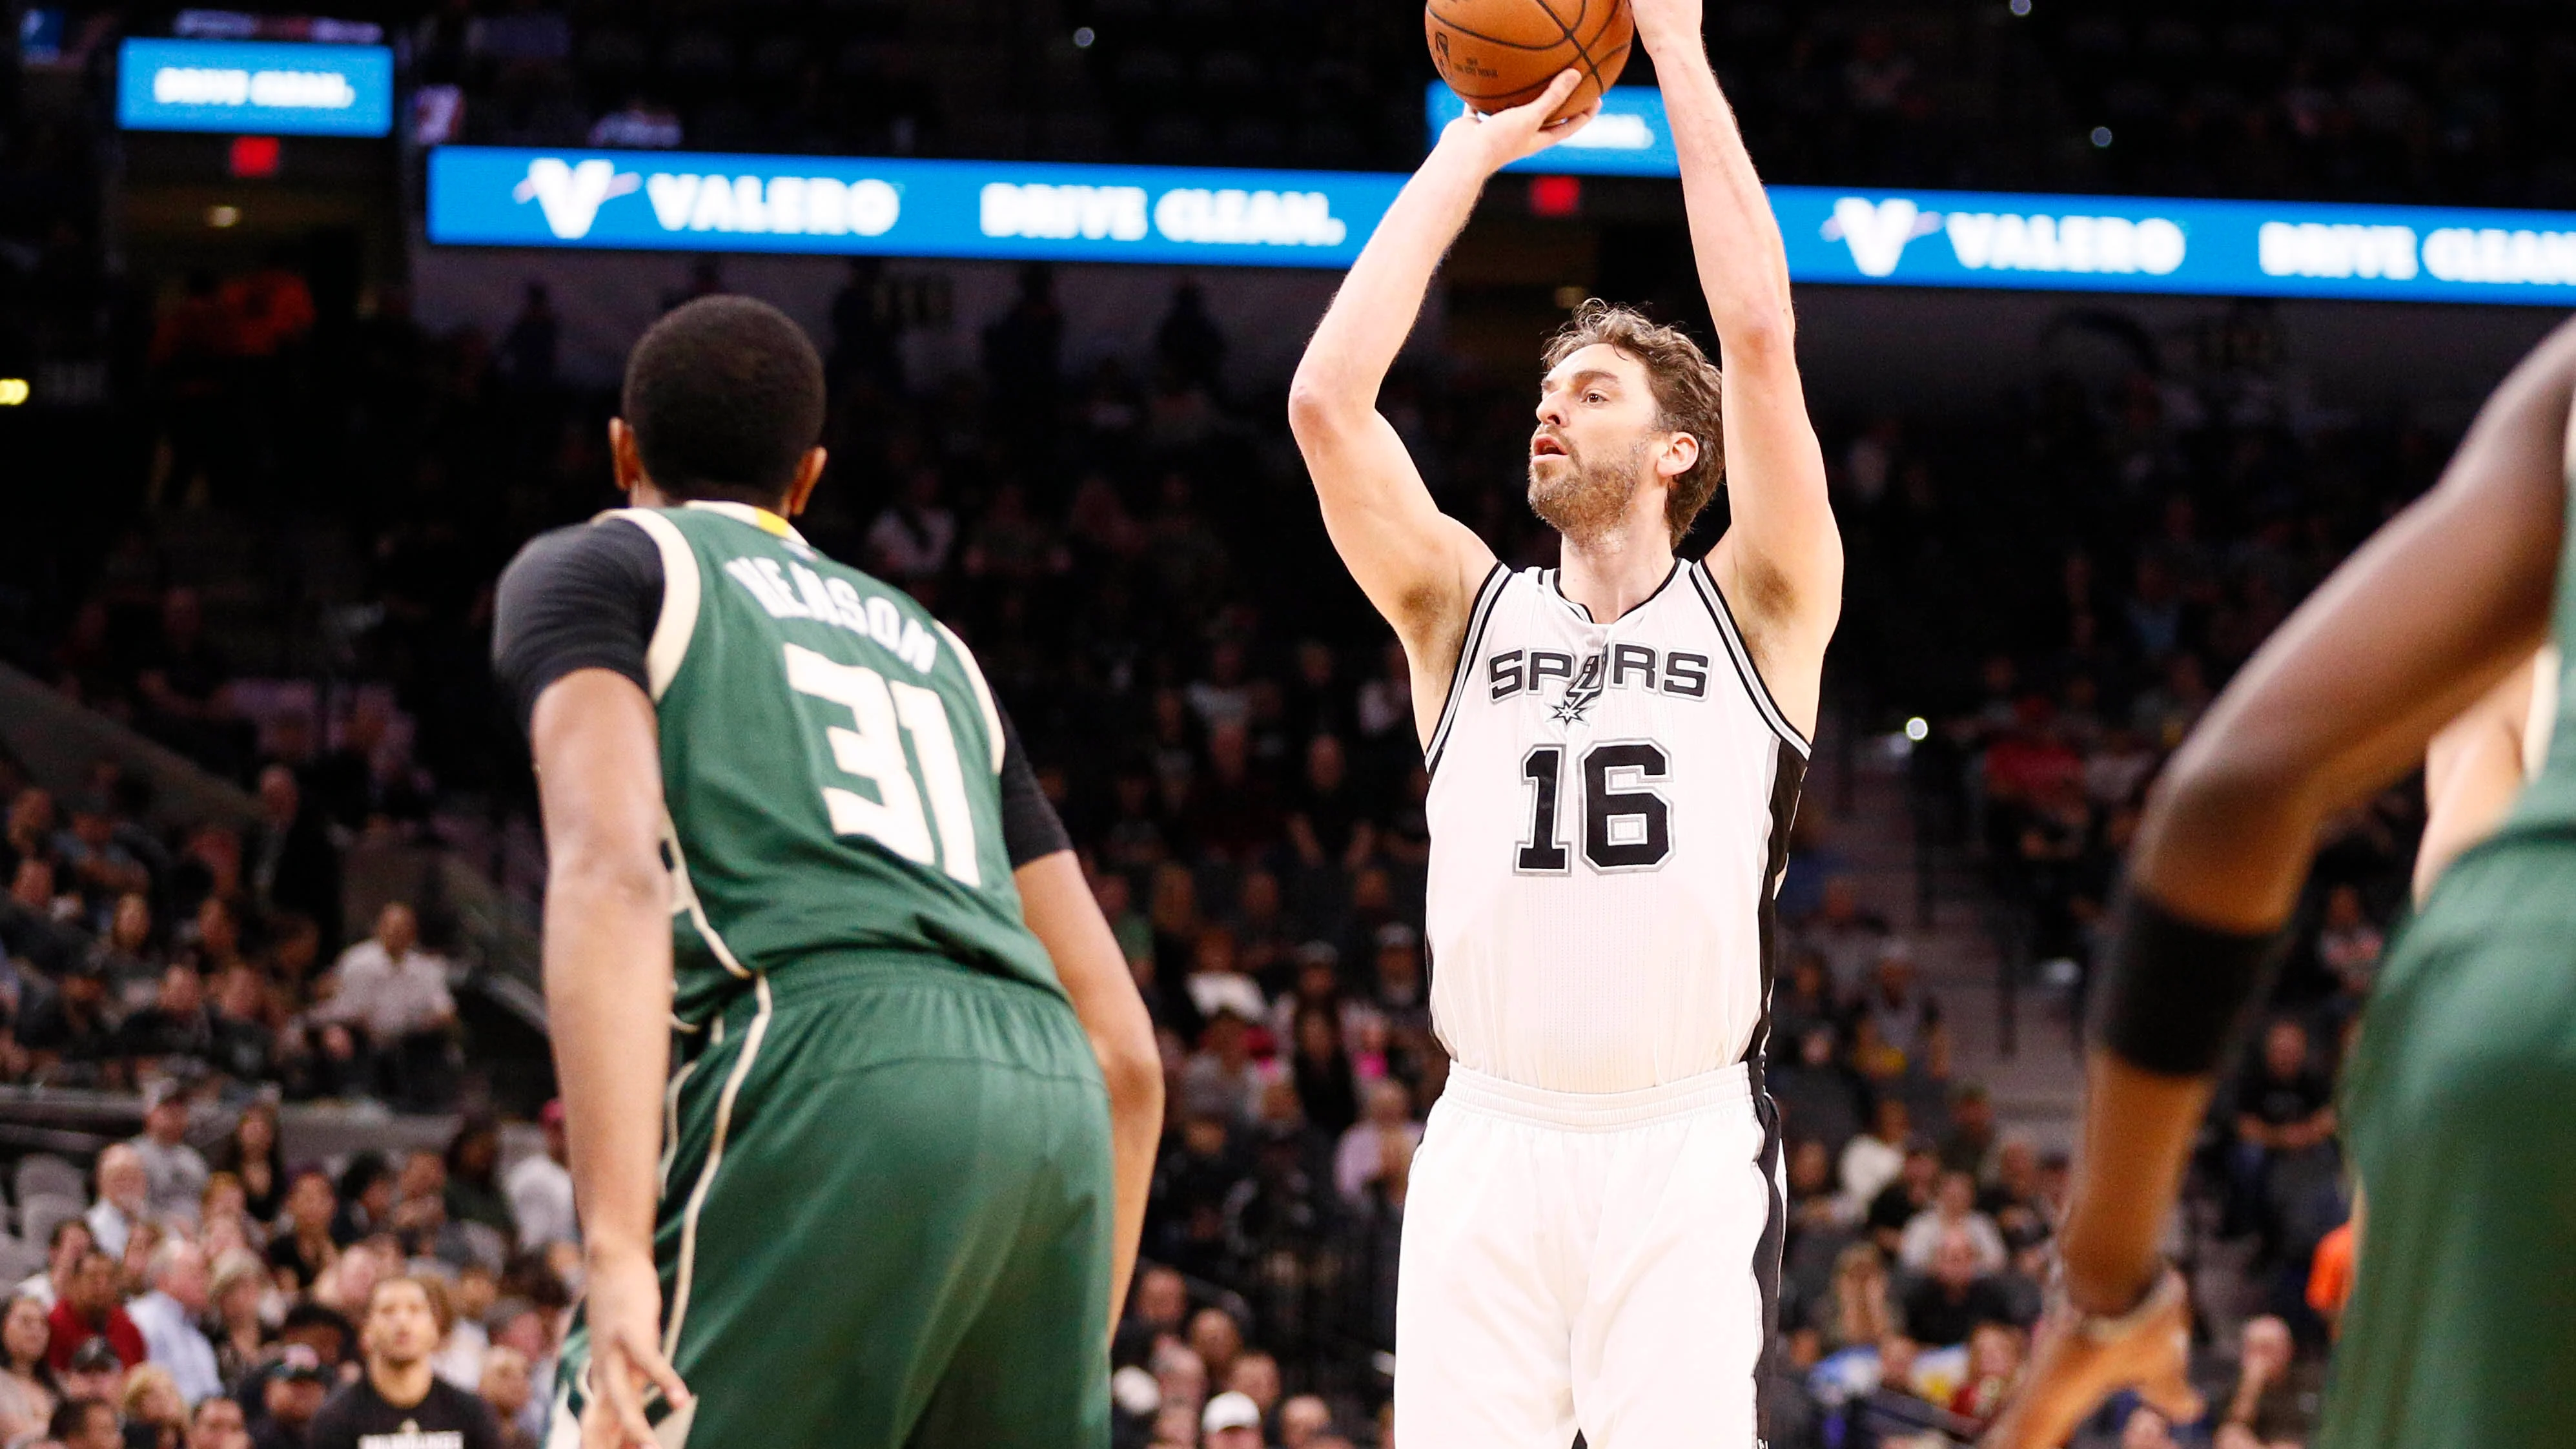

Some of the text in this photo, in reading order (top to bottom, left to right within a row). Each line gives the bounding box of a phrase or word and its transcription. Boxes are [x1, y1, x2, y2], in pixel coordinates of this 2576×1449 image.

[647, 172, 901, 236] VALERO
[980, 182, 1148, 242] DRIVE
[1947, 212, 2187, 275] VALERO
[2259, 221, 2418, 280] DRIVE
[783, 641, 981, 886] 31
[1512, 737, 1677, 877] 16
